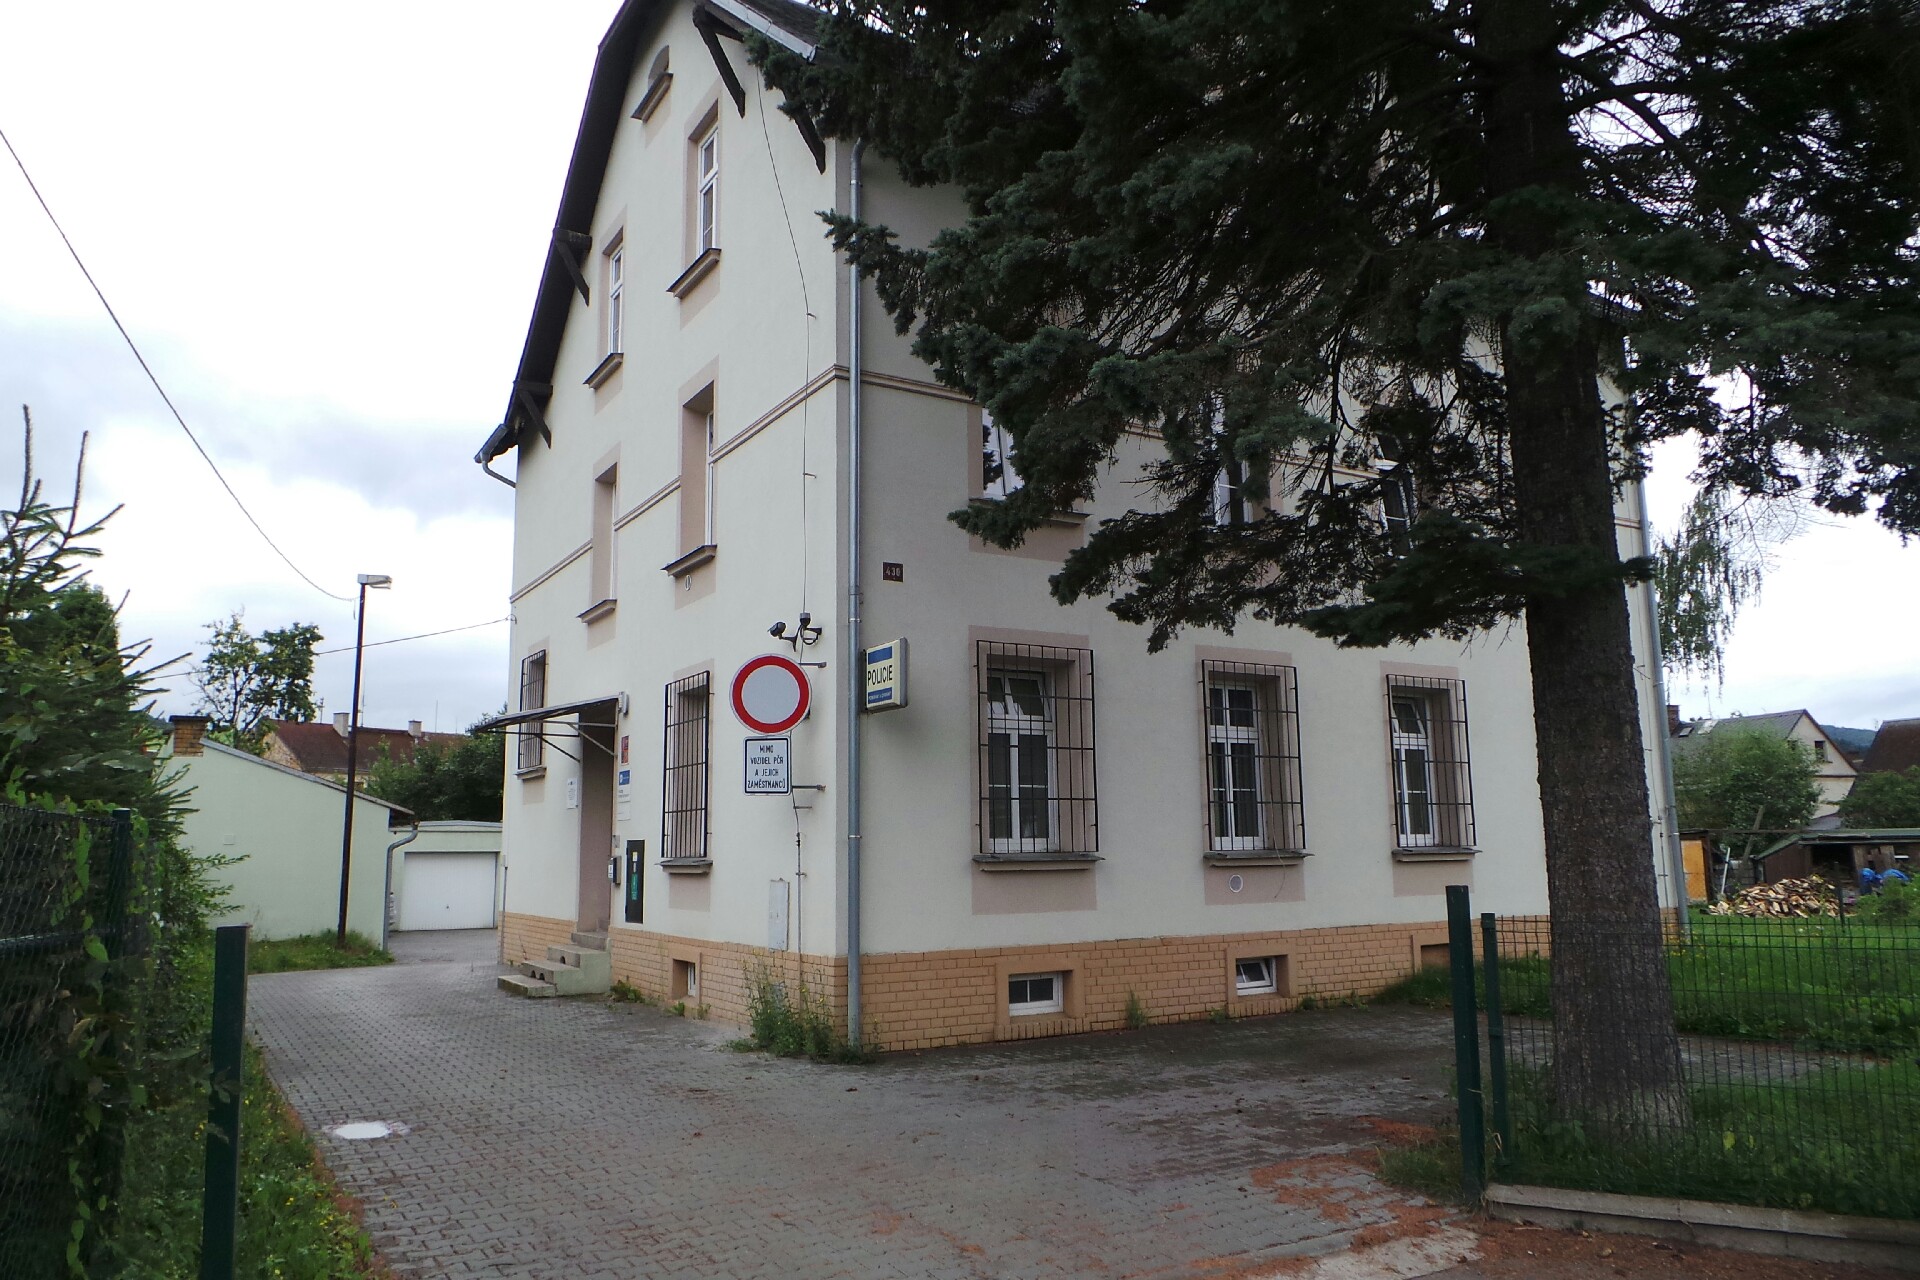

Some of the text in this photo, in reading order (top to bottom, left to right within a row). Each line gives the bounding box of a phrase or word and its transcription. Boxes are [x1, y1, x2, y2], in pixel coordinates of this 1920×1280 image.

[868, 665, 892, 686] POLICIE
[759, 745, 774, 753] MIMO
[748, 779, 786, 788] ZAMĚSTNANCŮ
